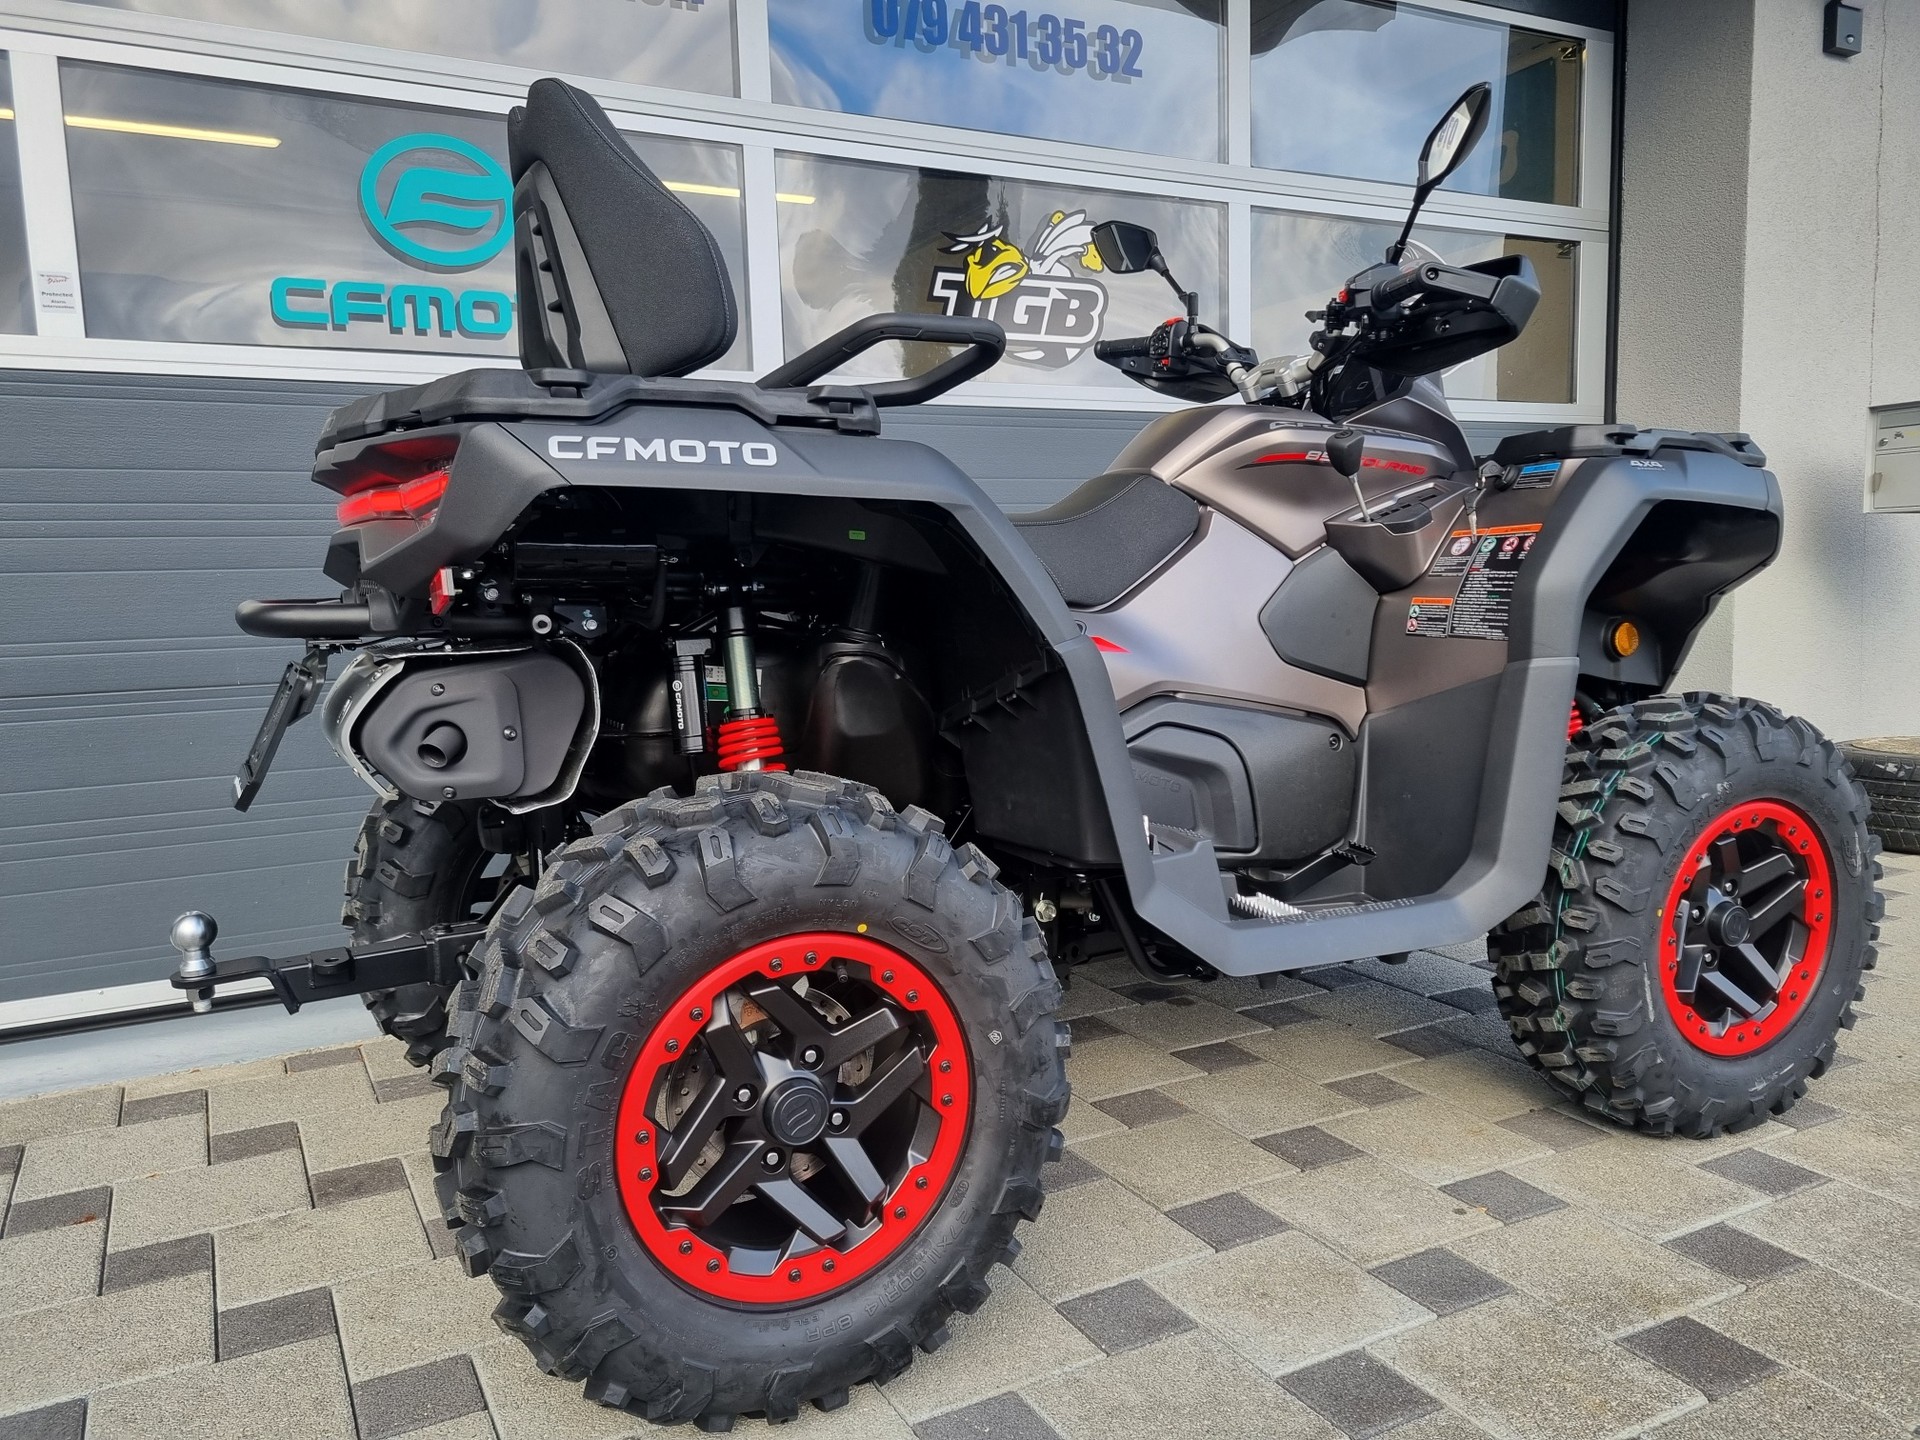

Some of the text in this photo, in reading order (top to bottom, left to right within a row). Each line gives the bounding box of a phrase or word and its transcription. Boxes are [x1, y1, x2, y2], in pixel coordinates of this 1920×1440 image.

[872, 0, 1144, 78] 079 431 35 32
[271, 276, 515, 334] CFMO
[547, 434, 778, 467] CFMOTO
[674, 692, 685, 730] CFMOTO
[574, 1030, 640, 1201] STAG
